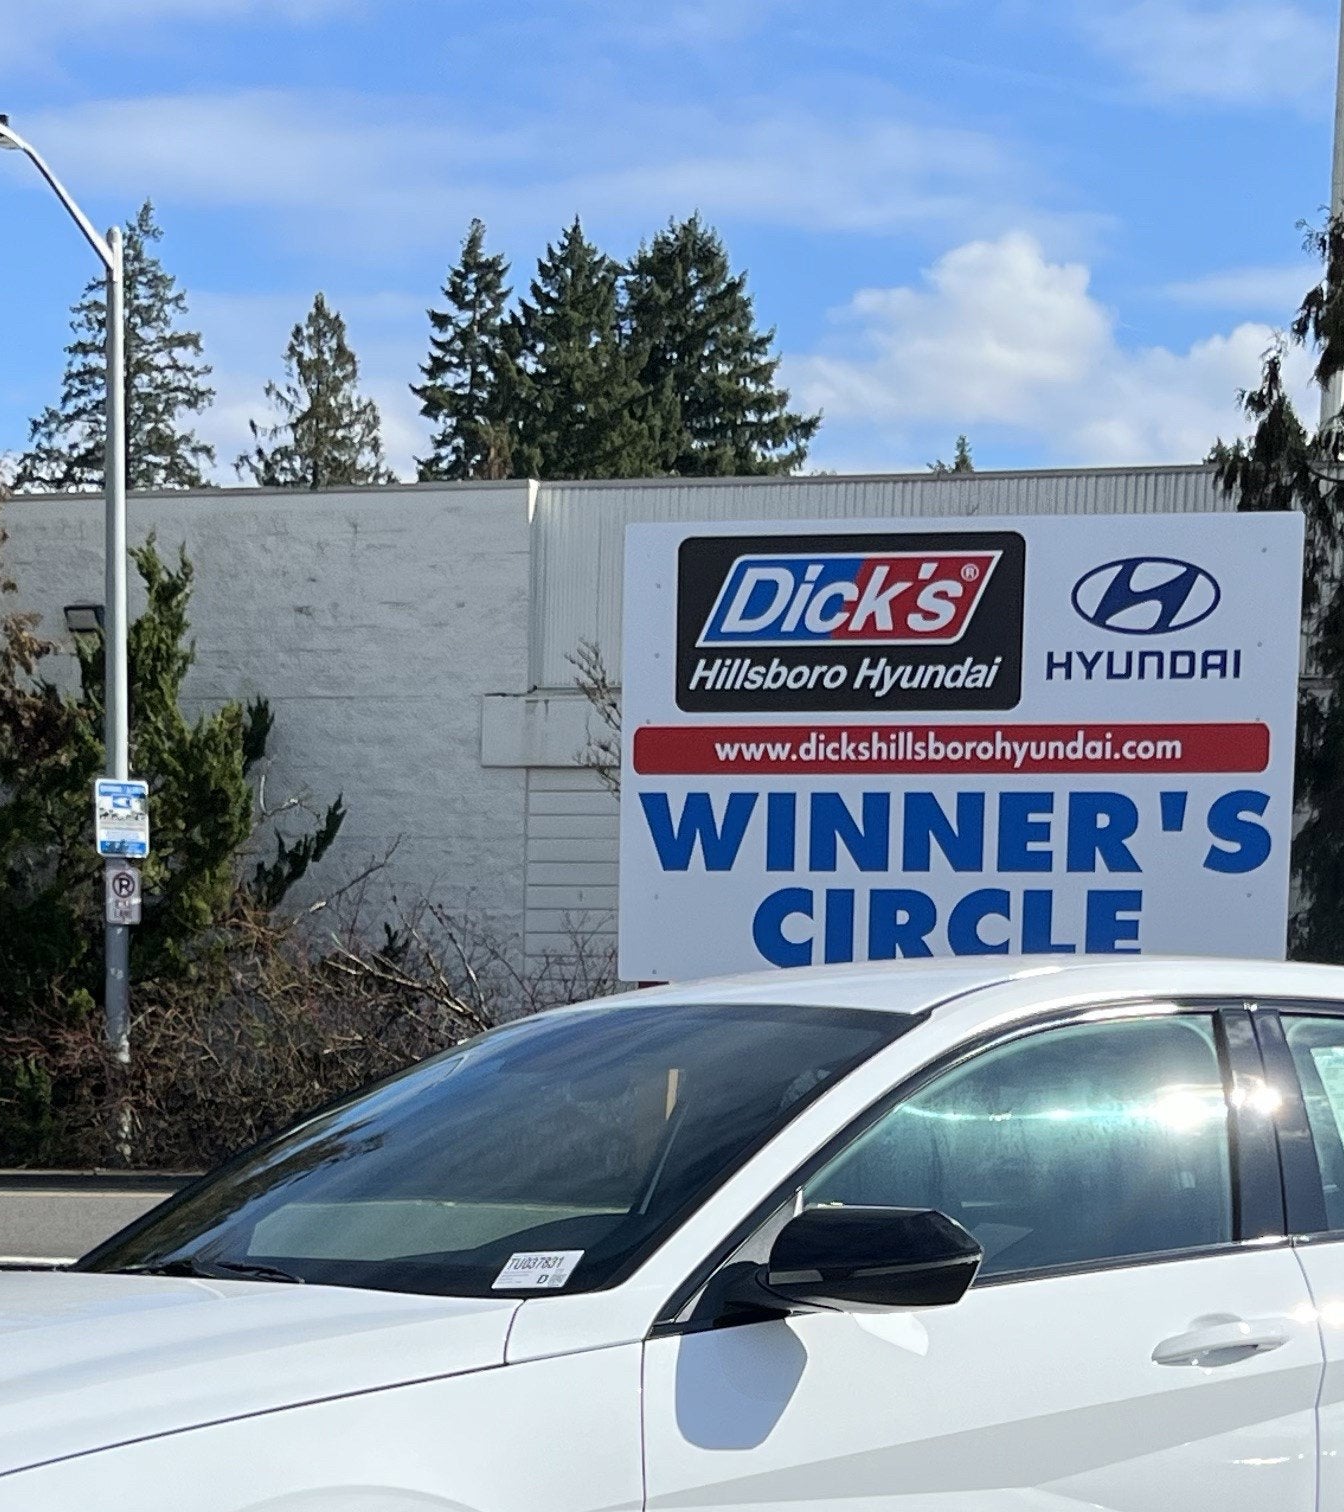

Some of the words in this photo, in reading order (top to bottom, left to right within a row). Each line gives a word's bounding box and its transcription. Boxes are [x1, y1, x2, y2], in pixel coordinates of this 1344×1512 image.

[721, 562, 964, 634] Dick's
[689, 658, 848, 691] Hillsboro
[853, 656, 1004, 697] Hyundai
[1046, 649, 1241, 681] HYUNDAI
[715, 731, 1183, 768] www.dickshillsborohyundai.com
[639, 789, 1272, 874] WINNER'S
[752, 887, 1143, 968] CIRCLE
